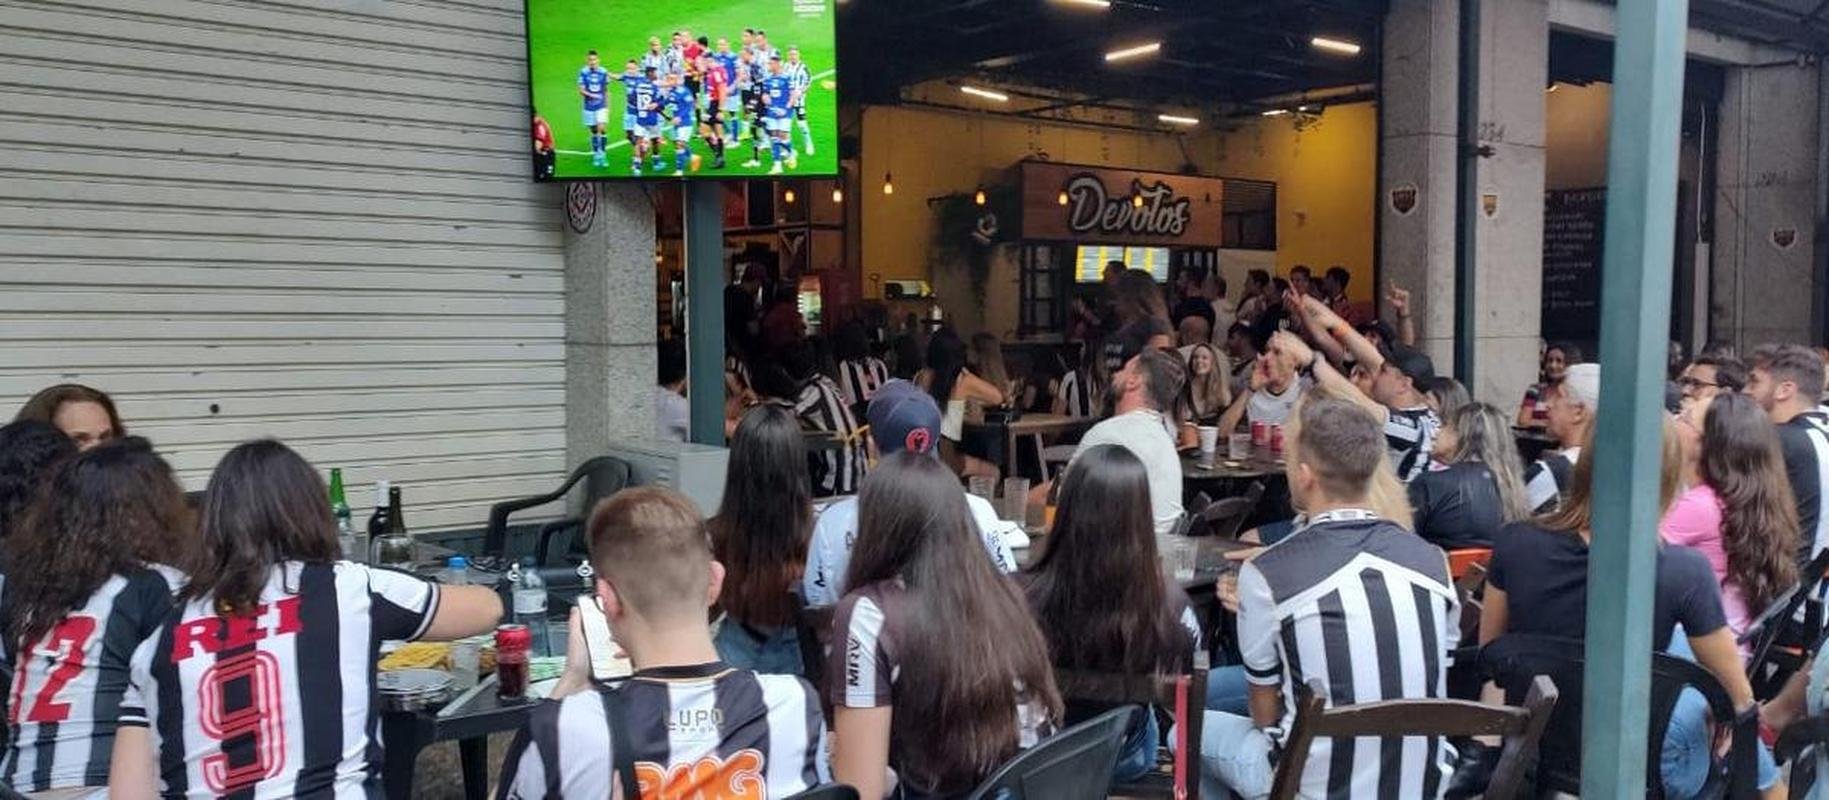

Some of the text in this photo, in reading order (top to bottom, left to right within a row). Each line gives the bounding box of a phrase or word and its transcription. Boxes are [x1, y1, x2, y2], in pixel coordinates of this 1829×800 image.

[1068, 176, 1190, 235] Devotos
[171, 596, 303, 664] REI
[848, 637, 861, 687] MRV
[197, 650, 285, 795] 9
